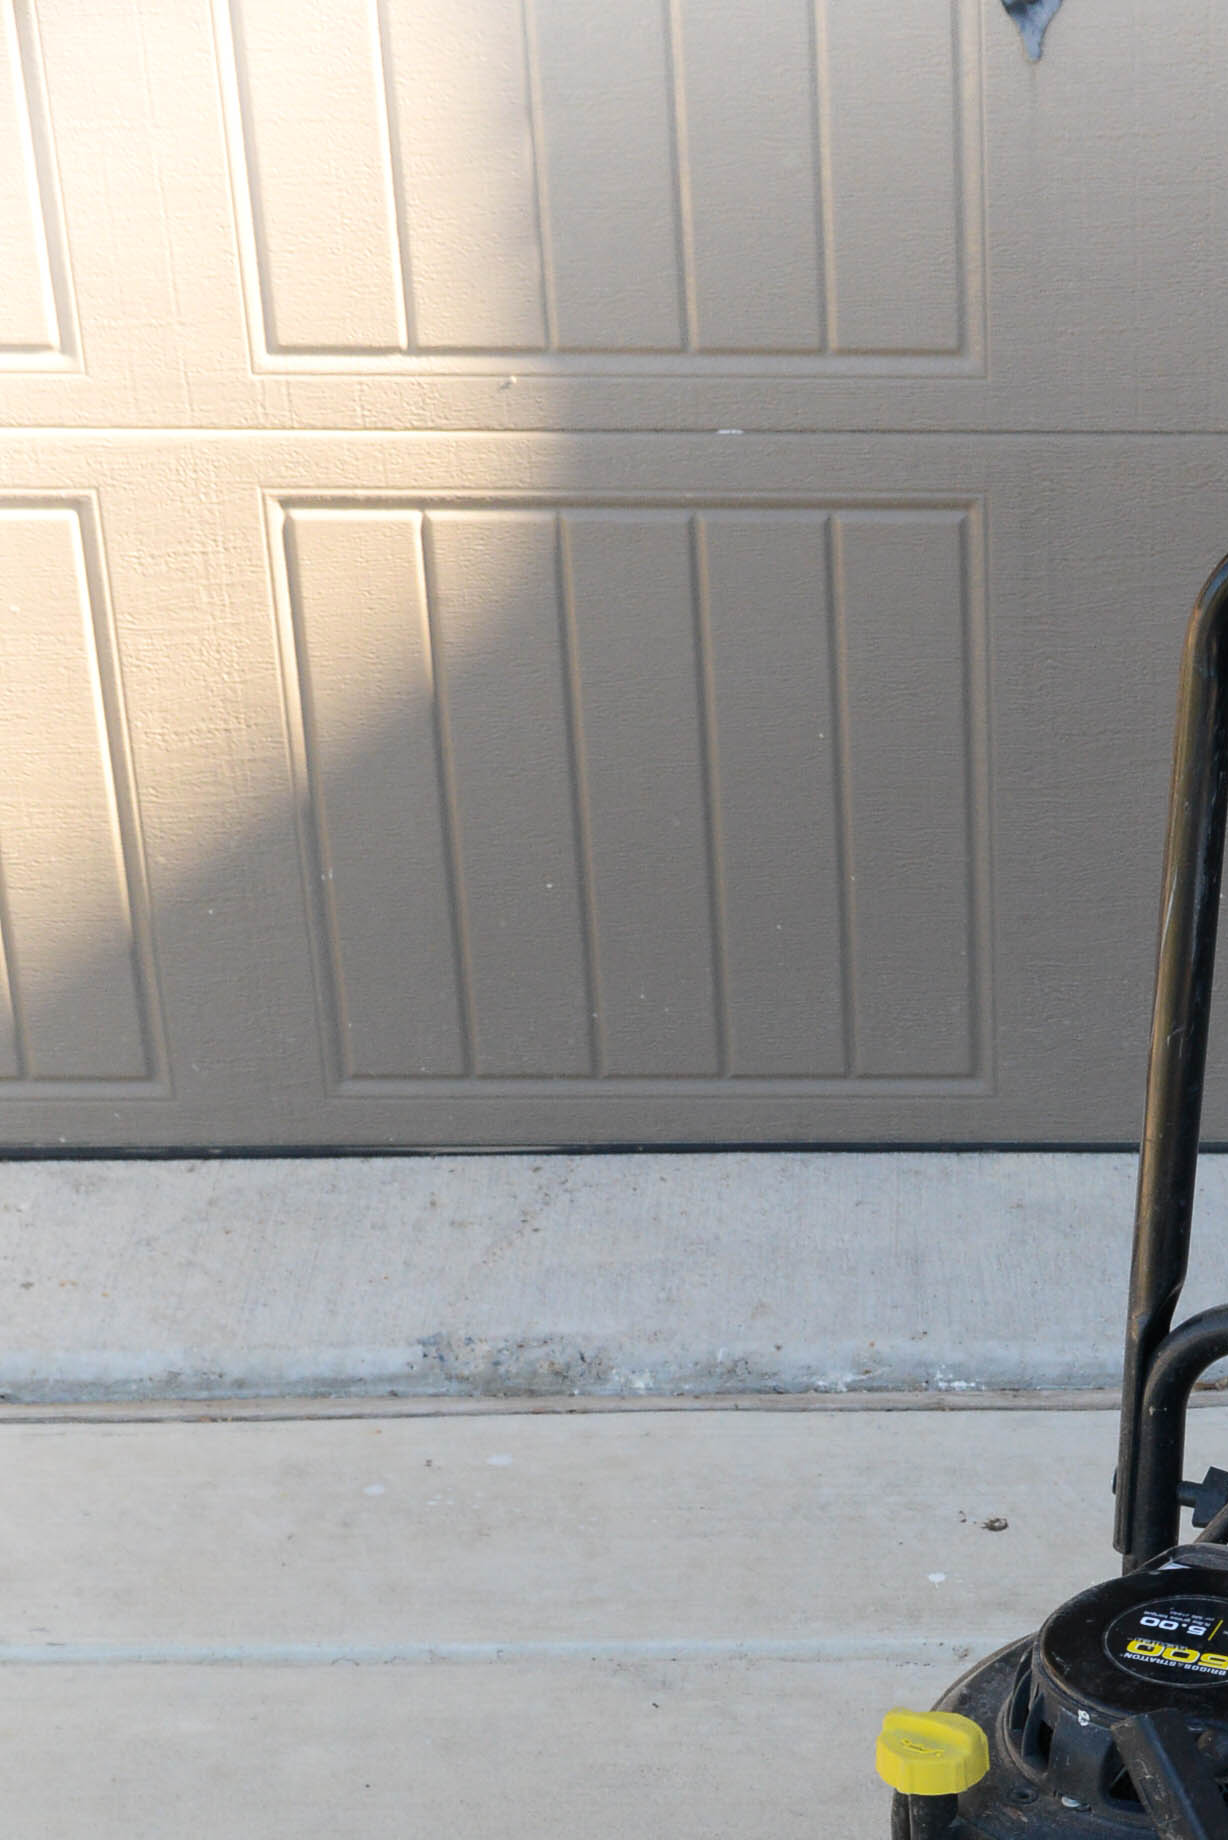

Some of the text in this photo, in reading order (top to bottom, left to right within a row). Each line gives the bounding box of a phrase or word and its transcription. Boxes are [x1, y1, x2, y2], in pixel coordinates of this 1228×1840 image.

[1139, 1616, 1207, 1636] 5.00
[1123, 1652, 1177, 1668] STRATTON
[1183, 1663, 1227, 1677] BRIGGS
